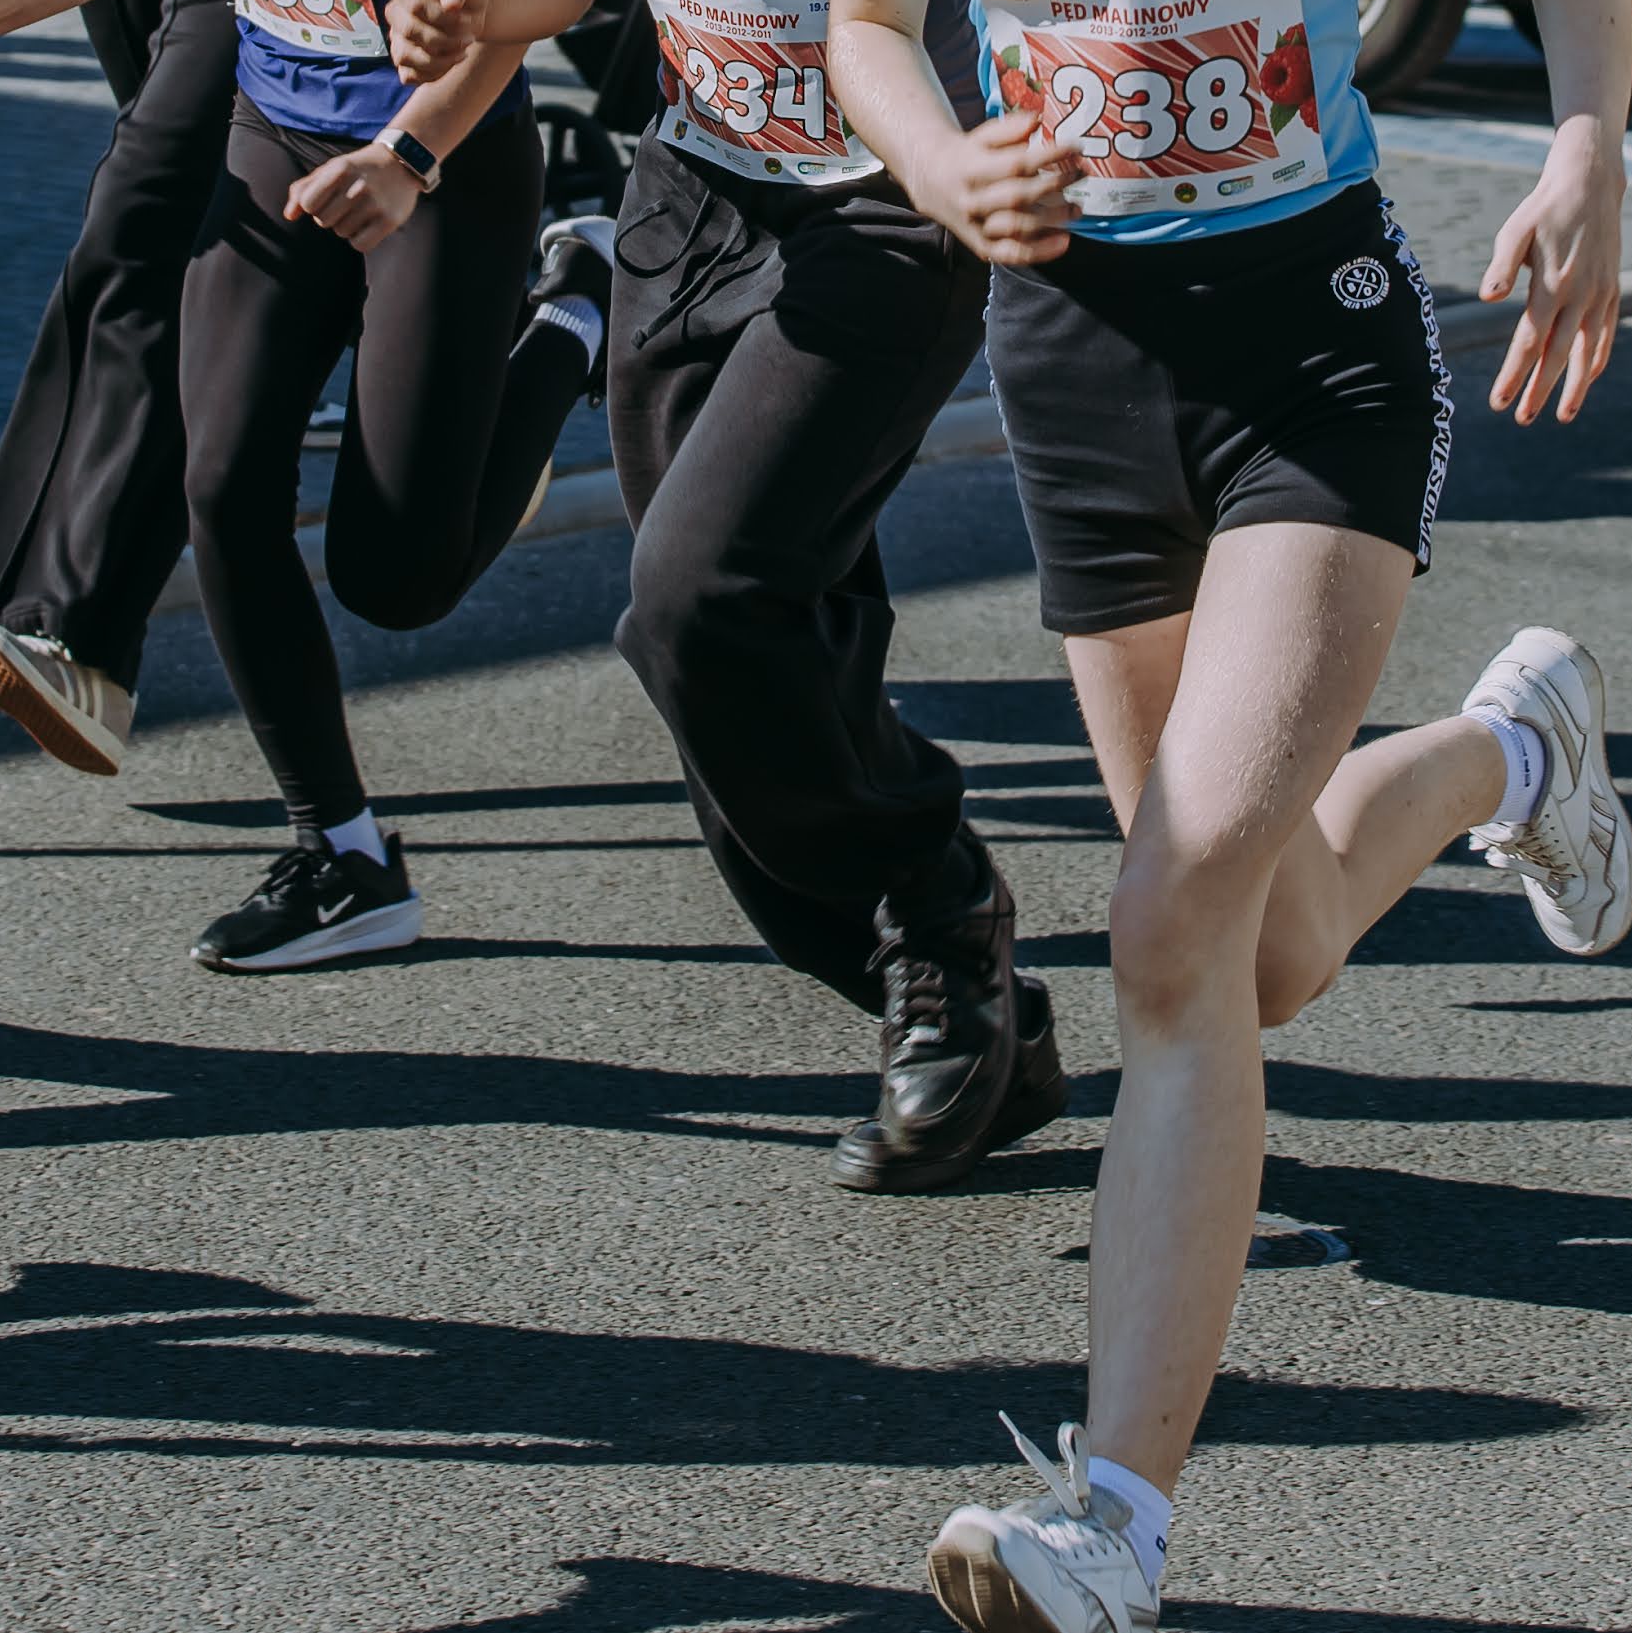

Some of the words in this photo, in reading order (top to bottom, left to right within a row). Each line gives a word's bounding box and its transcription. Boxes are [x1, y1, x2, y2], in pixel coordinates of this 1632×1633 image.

[705, 6, 801, 30] MALINOWY
[1049, 0, 1088, 24] PĘD
[704, 20, 772, 40] 2013-2012-2011
[1089, 23, 1179, 38] 2013-2012-2011
[685, 45, 827, 141] 234
[1050, 55, 1256, 162] 238
